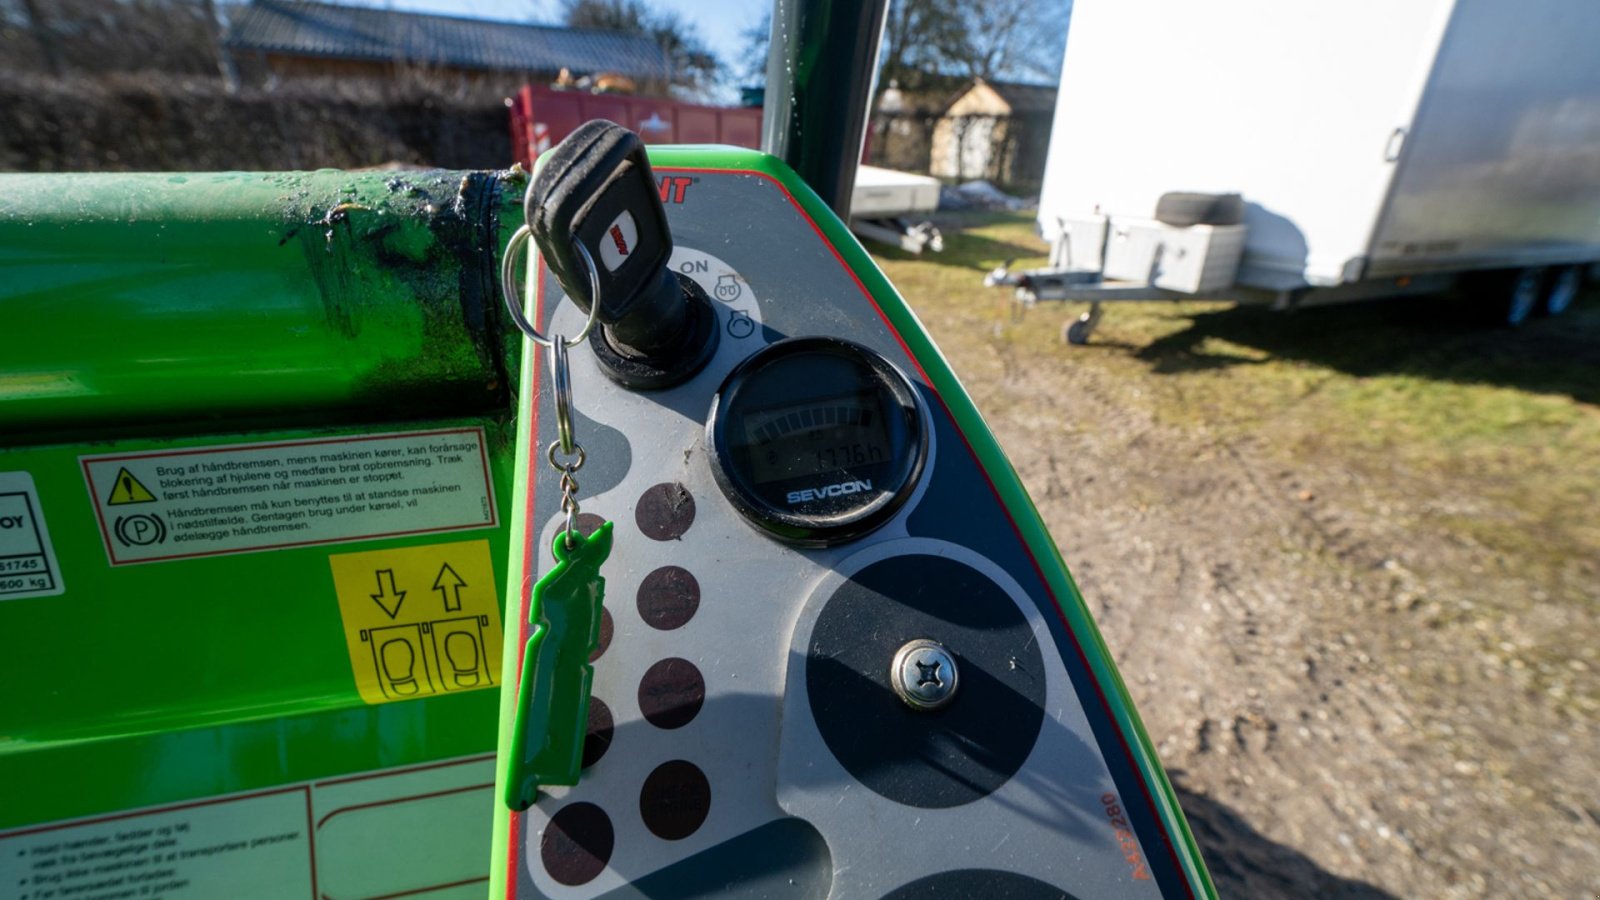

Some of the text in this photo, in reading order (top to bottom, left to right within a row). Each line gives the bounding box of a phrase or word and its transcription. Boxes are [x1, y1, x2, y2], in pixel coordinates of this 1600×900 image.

[680, 260, 708, 274] ON
[156, 466, 185, 476] Brug
[188, 464, 199, 474] af
[287, 456, 317, 464] mens
[320, 451, 374, 462] maskinen
[407, 446, 427, 455] kan
[429, 442, 477, 452] forårsage
[160, 477, 213, 489] blokering
[216, 474, 227, 483] af
[230, 471, 271, 484] hjulene
[274, 470, 288, 479] og
[292, 466, 336, 477] medføre
[340, 463, 360, 473] brat
[438, 454, 463, 464] Træk
[163, 491, 189, 500] først
[192, 485, 270, 498] håndbremsen
[273, 482, 290, 490] når
[294, 474, 346, 488] maskinen
[786, 478, 873, 504] SEVCON
[166, 505, 247, 519] Håndbremsen
[251, 500, 268, 510] må
[271, 498, 291, 508] kun
[294, 496, 340, 508] benyttes
[355, 492, 365, 501] at
[368, 489, 409, 499] standse
[412, 484, 461, 495] maskinen
[251, 510, 305, 523] Gentagen
[308, 507, 333, 518] brug
[336, 503, 365, 514] under
[406, 499, 417, 507] vil
[174, 531, 230, 542] ødelægge
[29, 578, 46, 589] kg
